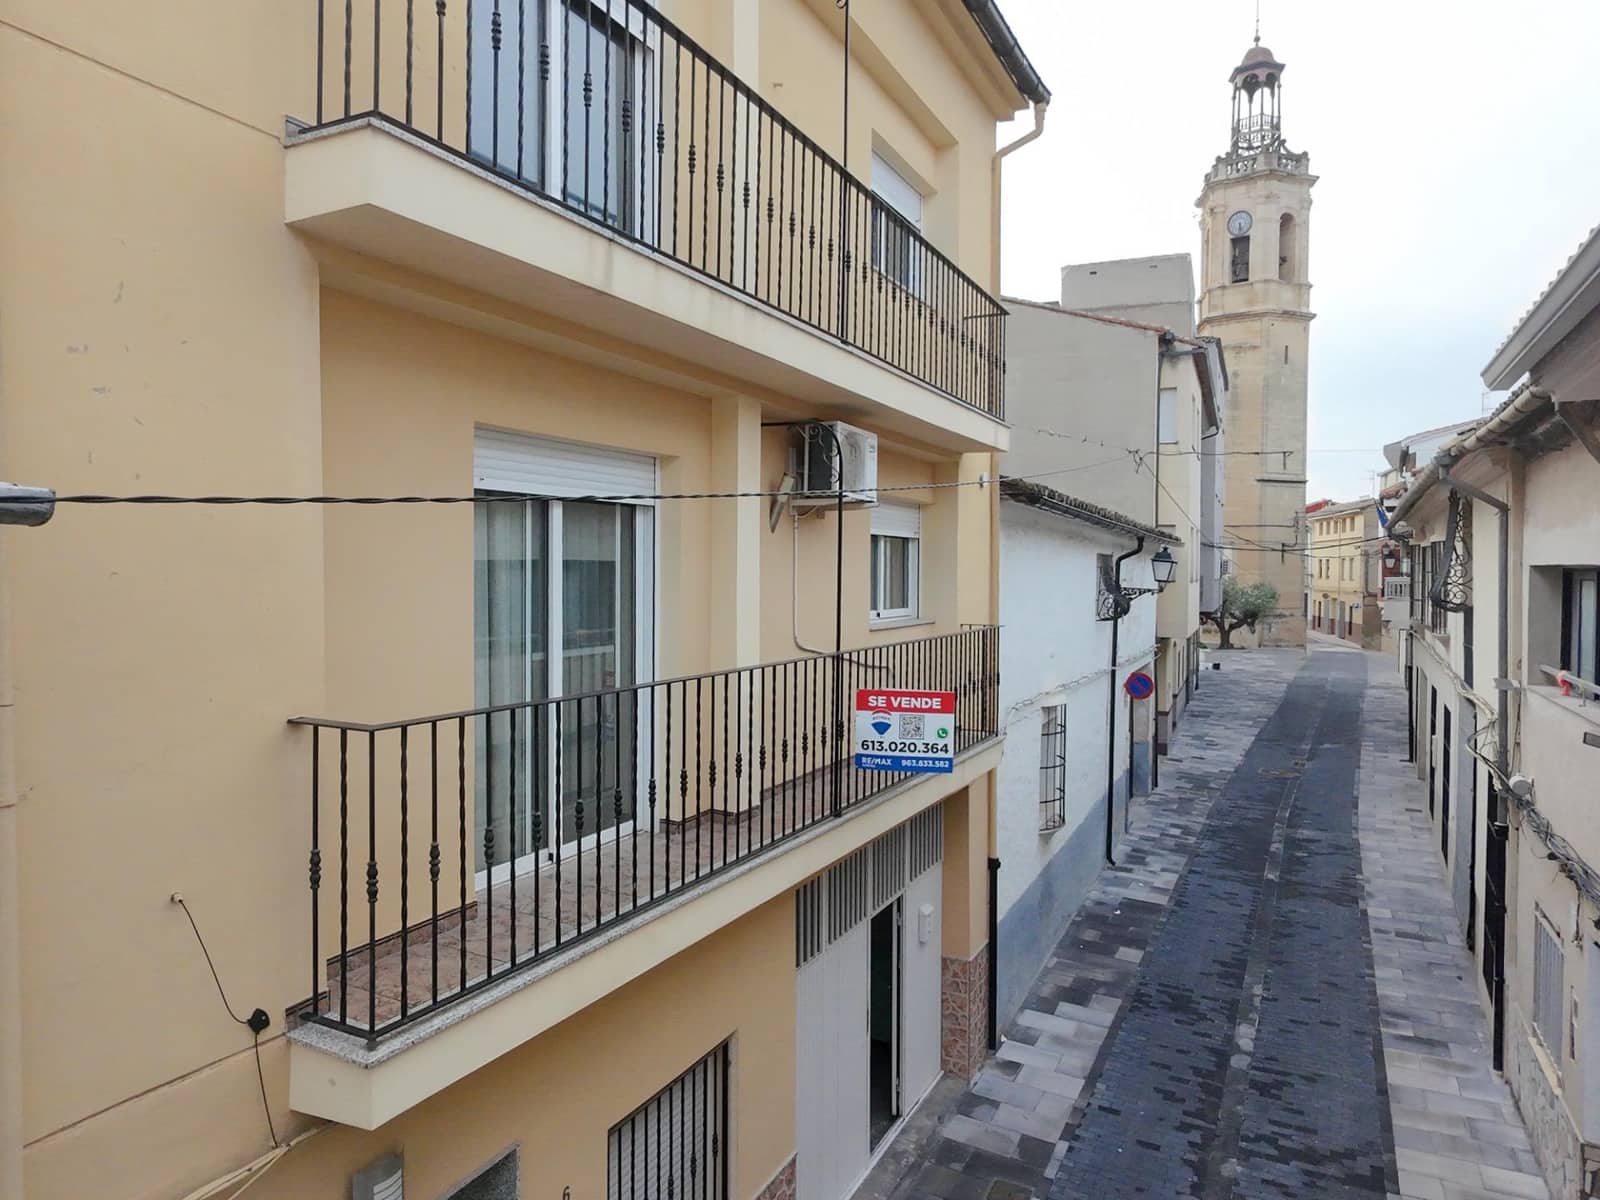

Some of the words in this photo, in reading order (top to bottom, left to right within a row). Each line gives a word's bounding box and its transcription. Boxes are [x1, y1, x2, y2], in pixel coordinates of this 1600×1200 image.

[868, 695, 887, 707] SE
[891, 696, 942, 709] VENDE
[861, 739, 949, 754] 613.020.364
[861, 757, 892, 766] RE/MAX
